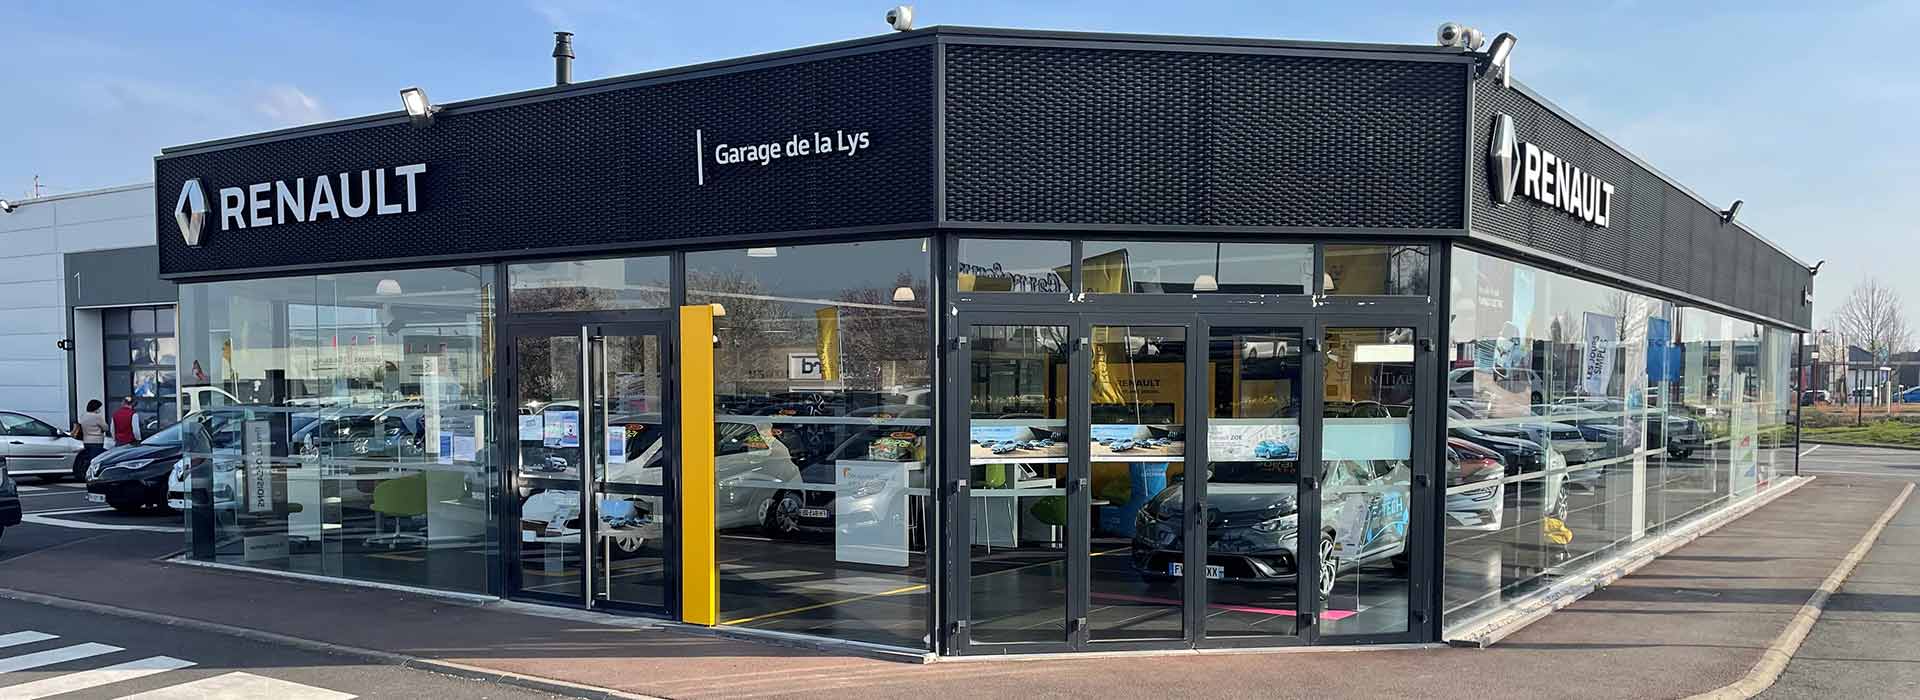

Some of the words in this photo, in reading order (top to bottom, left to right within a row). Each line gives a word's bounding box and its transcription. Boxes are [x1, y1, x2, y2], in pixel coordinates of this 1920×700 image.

[716, 142, 781, 167] Garage
[786, 135, 810, 157] de
[814, 131, 832, 154] la
[836, 129, 870, 157] Lys
[219, 163, 427, 231] RENAULT
[1523, 142, 1615, 229] RENAULT
[73, 272, 81, 301] 1
[1589, 335, 1600, 363] JOURS
[1117, 379, 1161, 387] RENAULT
